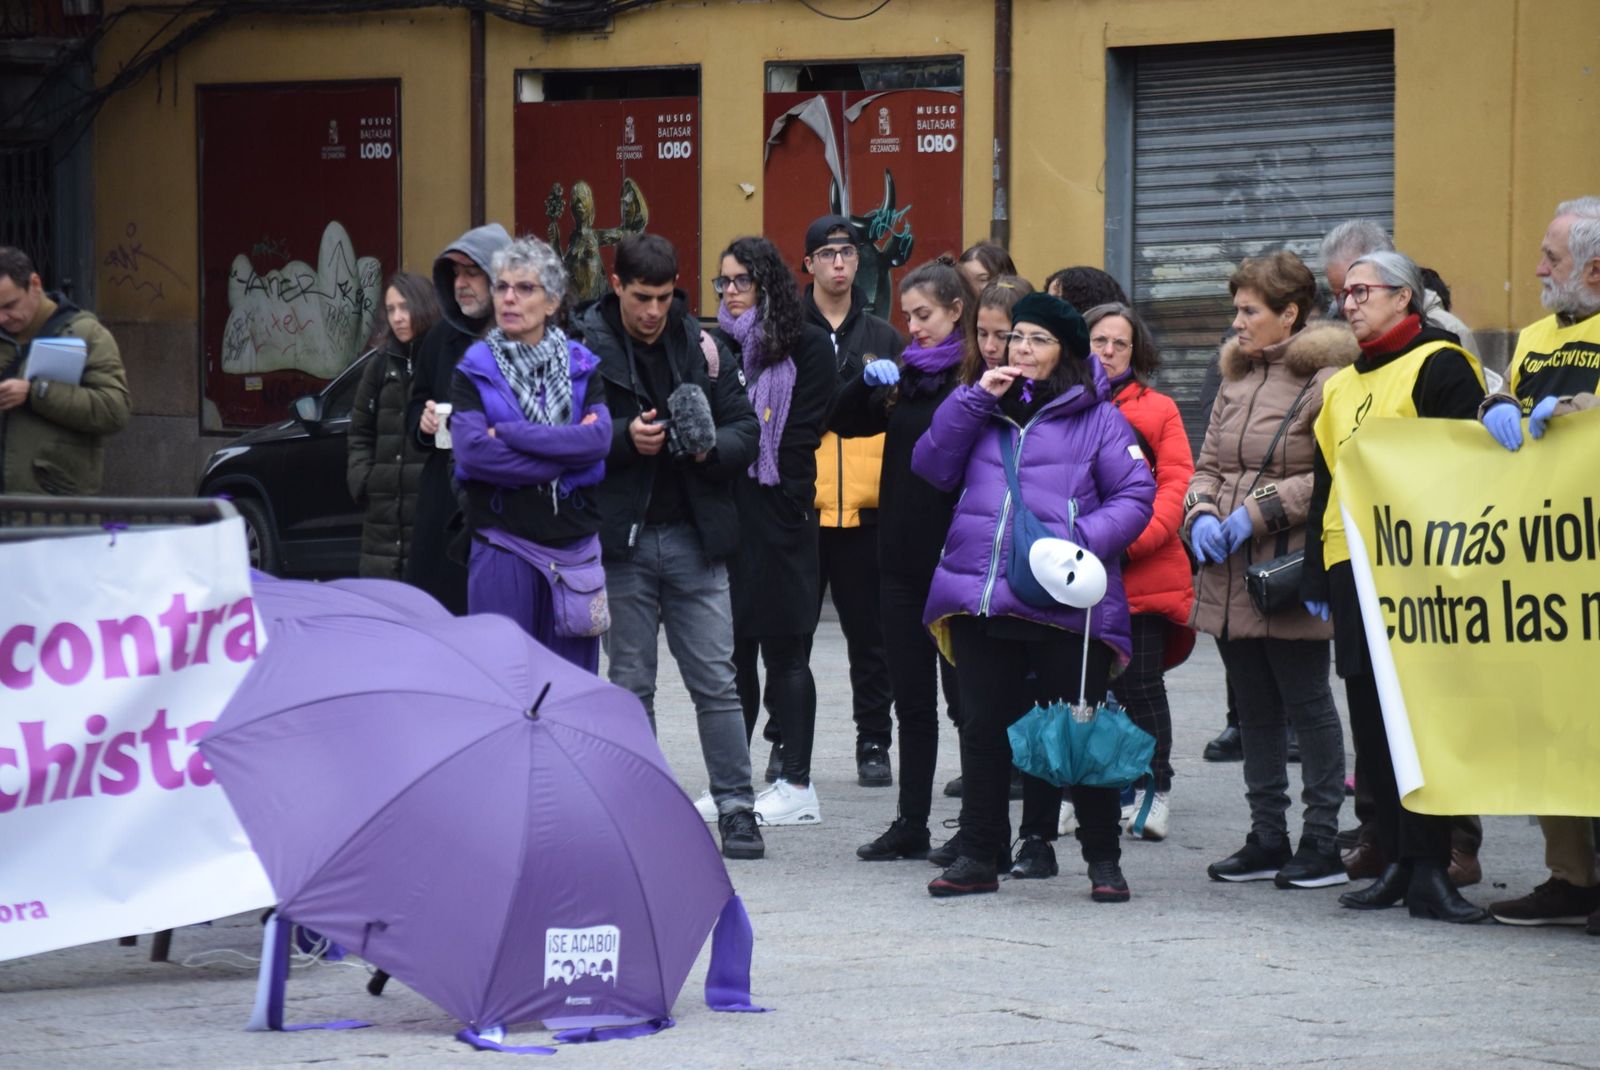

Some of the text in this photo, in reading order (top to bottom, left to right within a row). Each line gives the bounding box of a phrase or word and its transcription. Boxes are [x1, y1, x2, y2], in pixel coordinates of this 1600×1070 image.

[658, 114, 692, 123] MUSEO
[917, 106, 956, 115] MUSEO
[360, 117, 393, 126] MUSEO
[916, 119, 956, 130] BALTASAR
[360, 129, 393, 139] BALTASAR
[658, 127, 692, 138] BALTASAR
[360, 142, 392, 159] LOBO
[658, 141, 691, 159] LOBO
[917, 133, 956, 153] LOBO
[1373, 497, 1600, 567] No más viol
[1502, 580, 1569, 643] las
[0, 592, 260, 690] contra
[548, 929, 617, 953] ¡SE ACABÓ!
